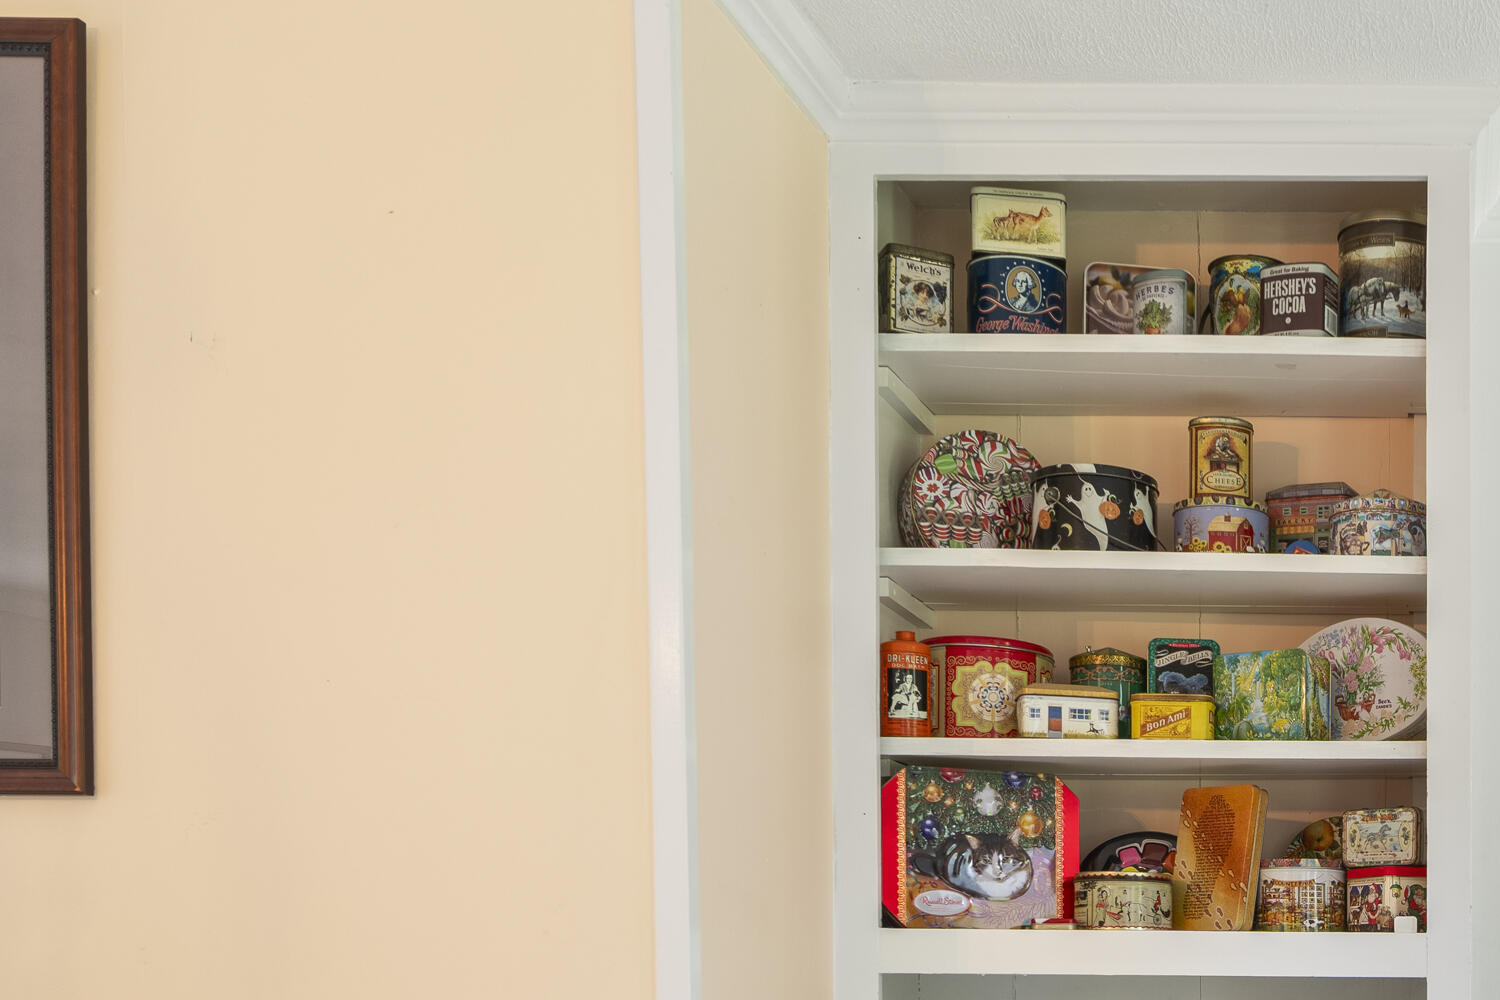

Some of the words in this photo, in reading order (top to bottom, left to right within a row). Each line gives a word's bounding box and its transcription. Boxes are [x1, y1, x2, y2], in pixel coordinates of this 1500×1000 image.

[905, 262, 942, 277] Welch's
[1269, 268, 1284, 276] Great
[1291, 265, 1310, 273] Baking
[1135, 285, 1175, 300] HERBES
[1263, 277, 1317, 300] HERSHEY'S
[1272, 296, 1306, 316] COCOA
[976, 317, 1010, 333] George
[1277, 517, 1314, 525] BAKERY
[887, 653, 929, 665] DRI-KLEEN
[1146, 717, 1166, 733] Bon
[1167, 709, 1186, 723] Ami
